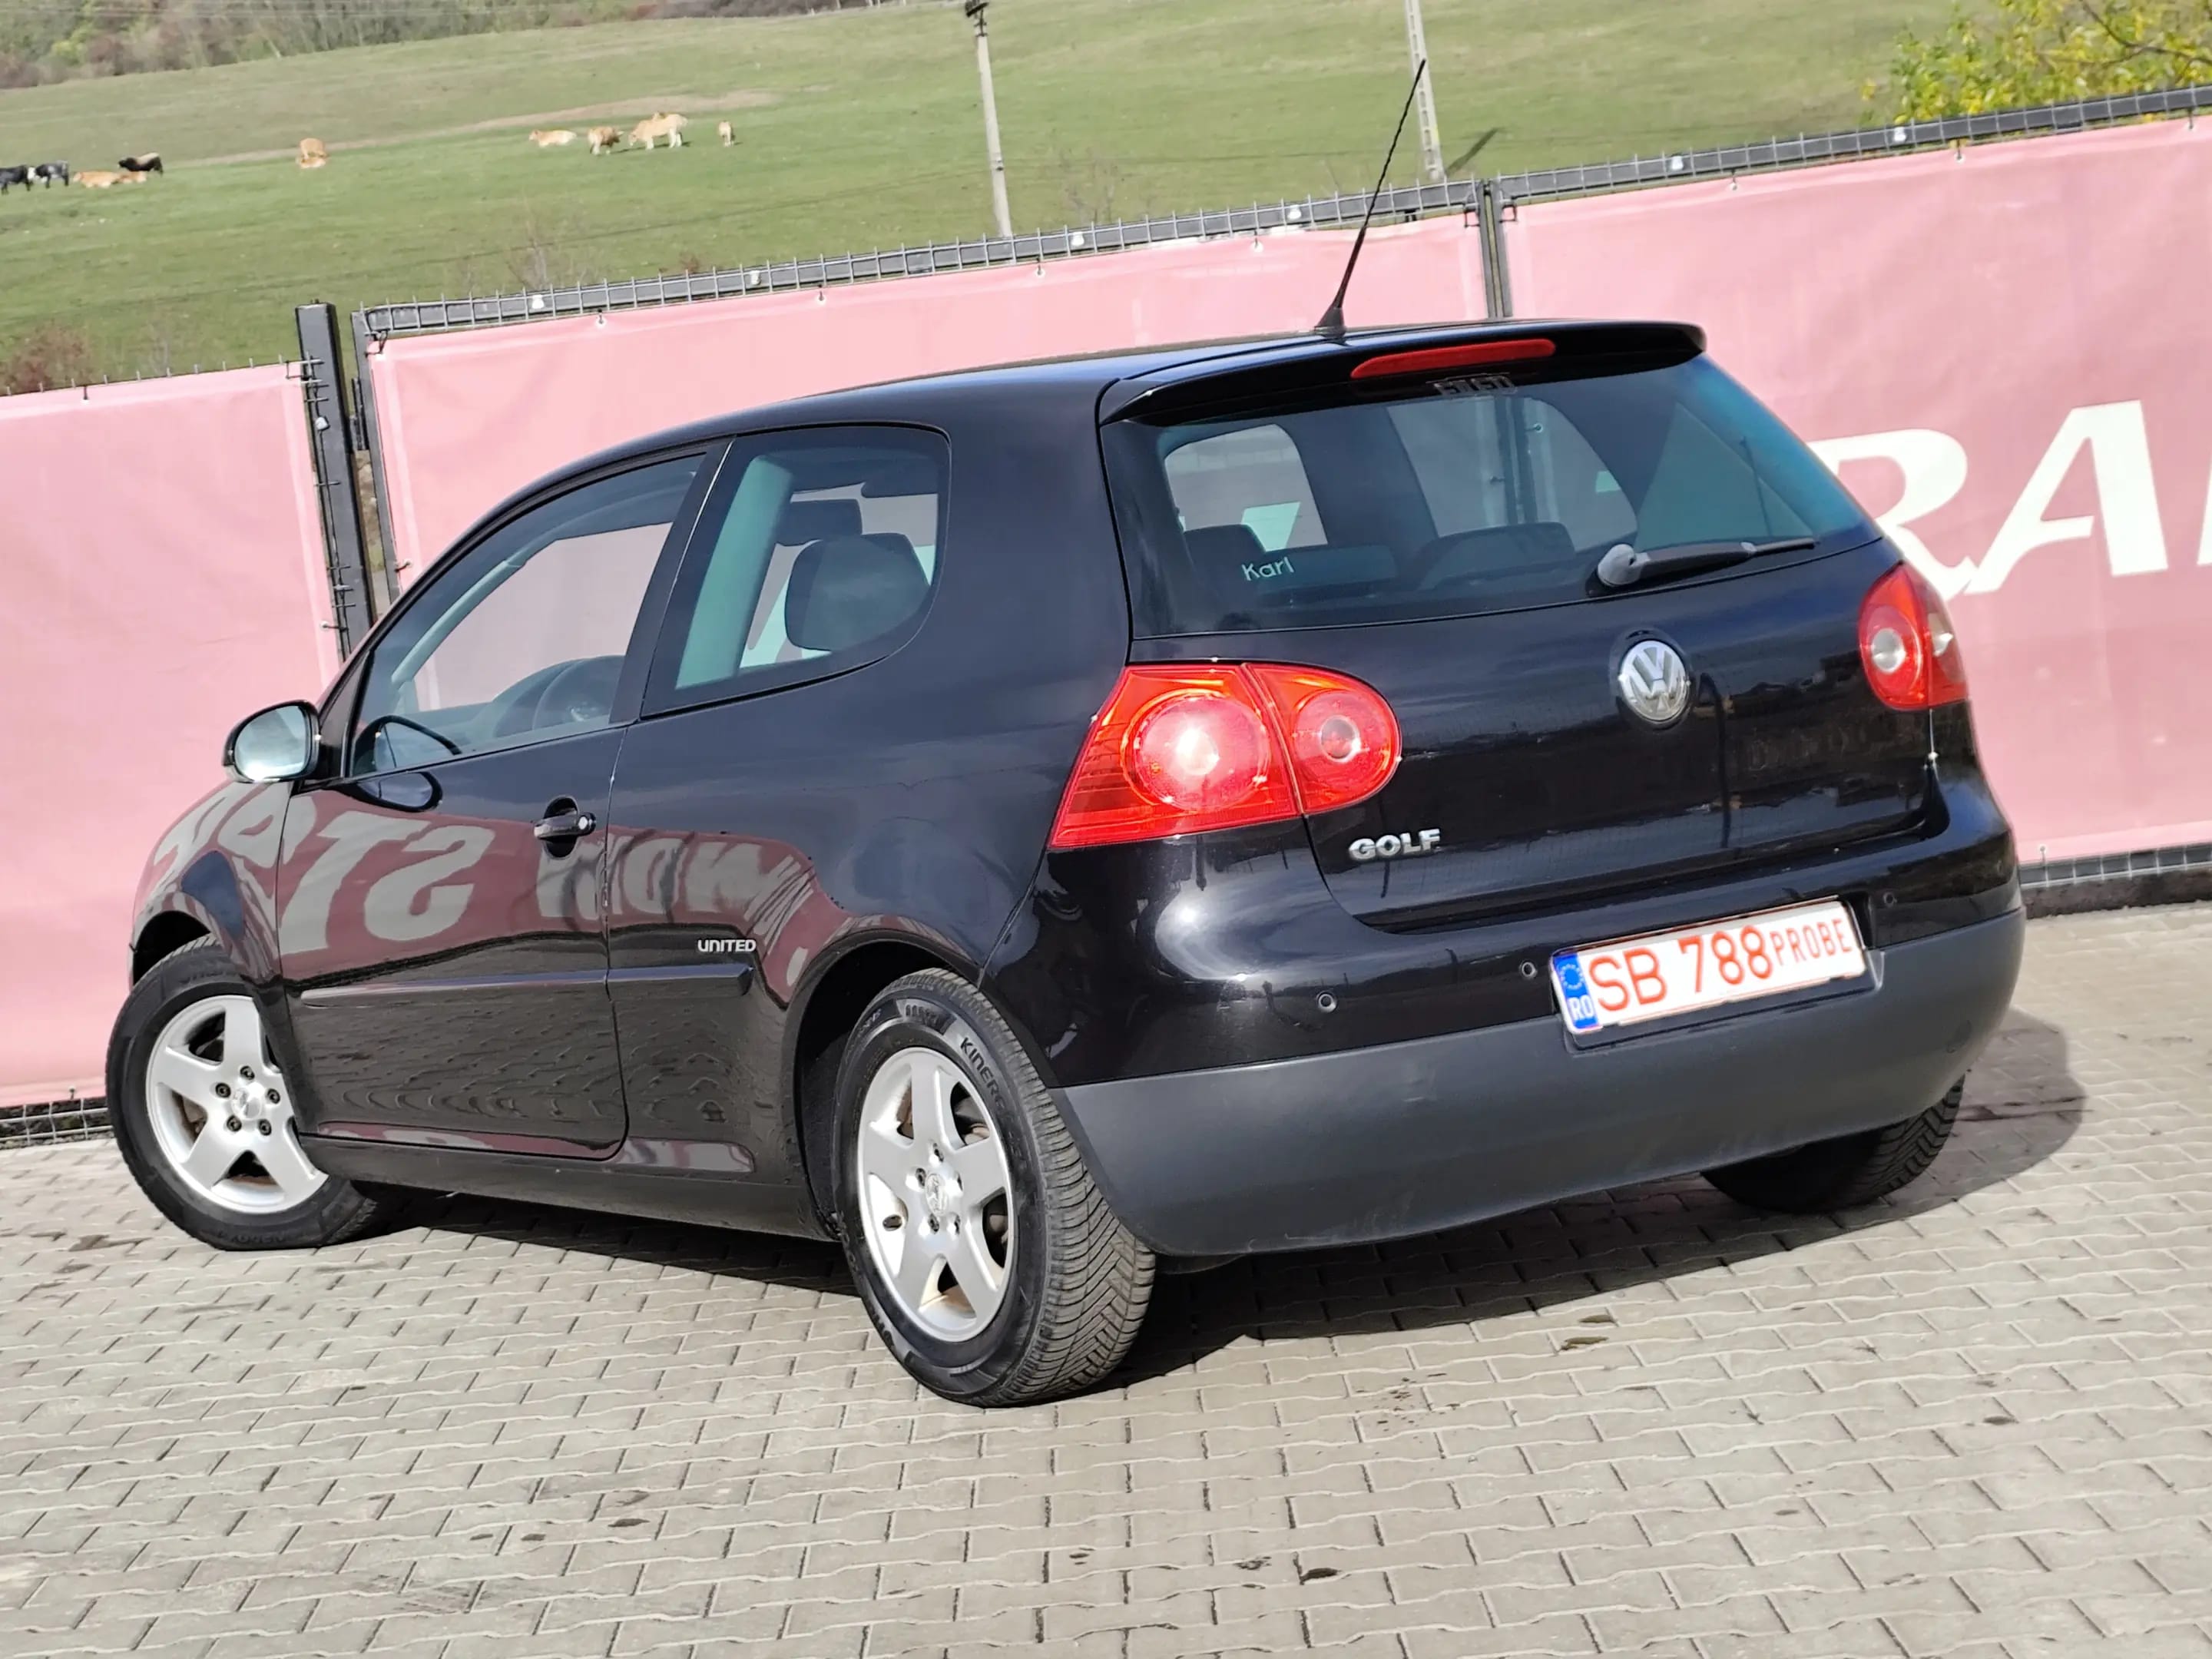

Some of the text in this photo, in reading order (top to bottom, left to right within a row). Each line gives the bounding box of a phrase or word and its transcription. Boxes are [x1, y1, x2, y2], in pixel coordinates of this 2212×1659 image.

[1806, 399, 2212, 602] RA
[1241, 556, 1295, 581] Karl
[1348, 828, 1441, 861] GOLF
[697, 939, 757, 952] UNITED
[1588, 918, 1852, 1012] SB 788 PROBE
[1568, 995, 1594, 1022] RO
[959, 1036, 1008, 1115] KINERG
